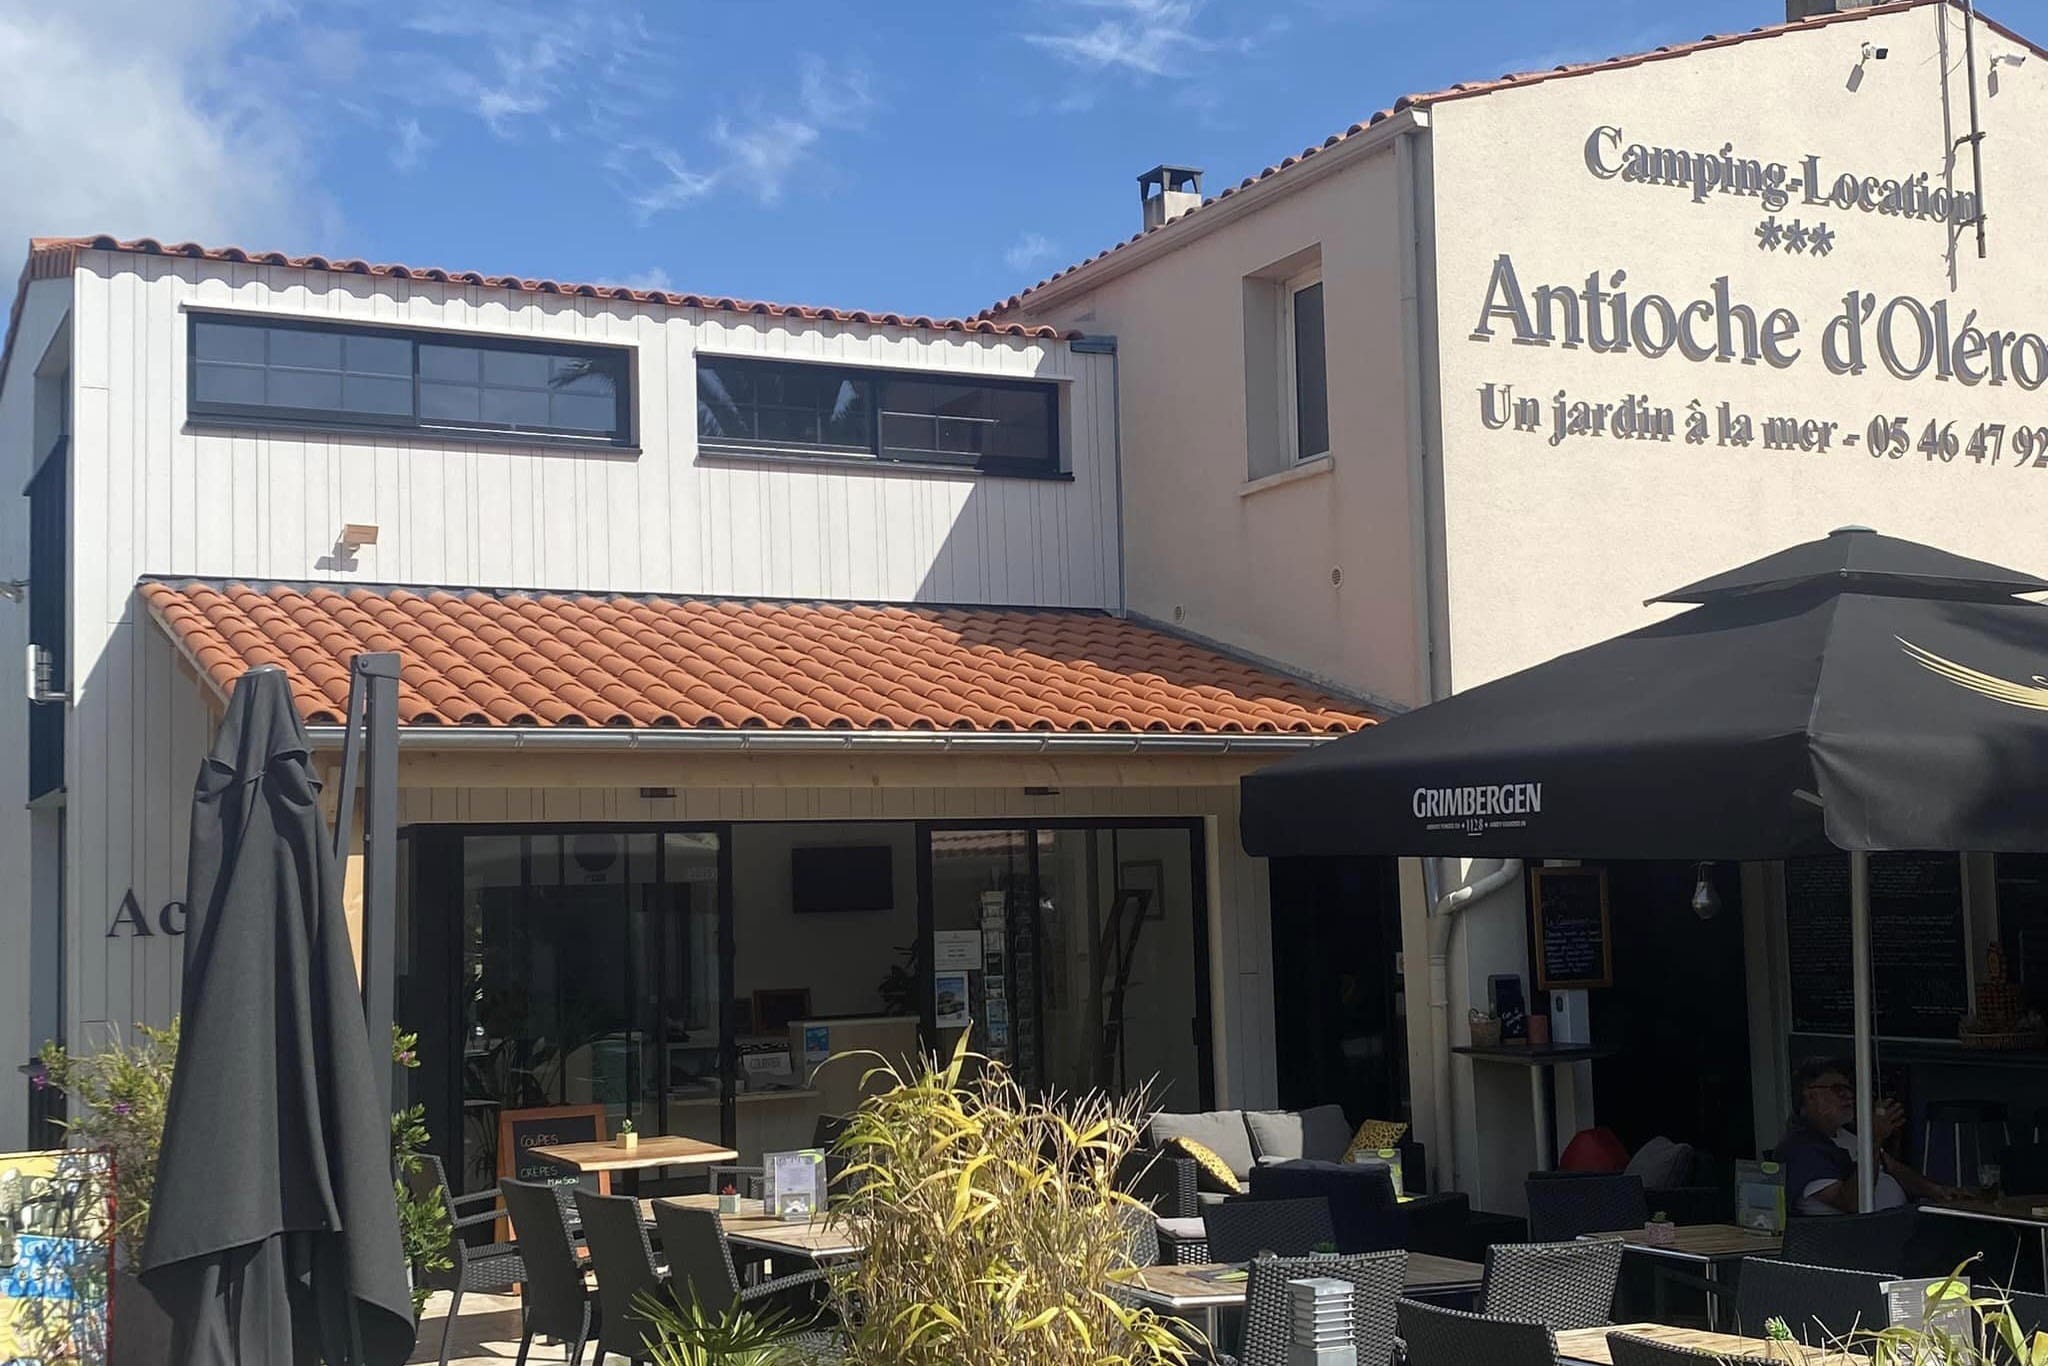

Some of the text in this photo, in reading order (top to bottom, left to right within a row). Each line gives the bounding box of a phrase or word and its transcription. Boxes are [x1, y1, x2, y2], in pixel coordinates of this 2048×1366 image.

[1584, 125, 1979, 225] Camping-Location
[1469, 254, 1801, 369] Antioche
[1476, 382, 1541, 433] Un
[1548, 389, 1676, 447] jardin
[1716, 401, 1755, 447] la
[1760, 416, 1838, 454] mer
[1867, 414, 1911, 460] 05
[1917, 418, 1959, 463] 46
[1965, 422, 2006, 466] 47
[2012, 425, 2048, 469] 92
[1413, 782, 1542, 818] GRIMBERGEN
[1466, 818, 1484, 832] 1128
[521, 1134, 558, 1147] COUPES
